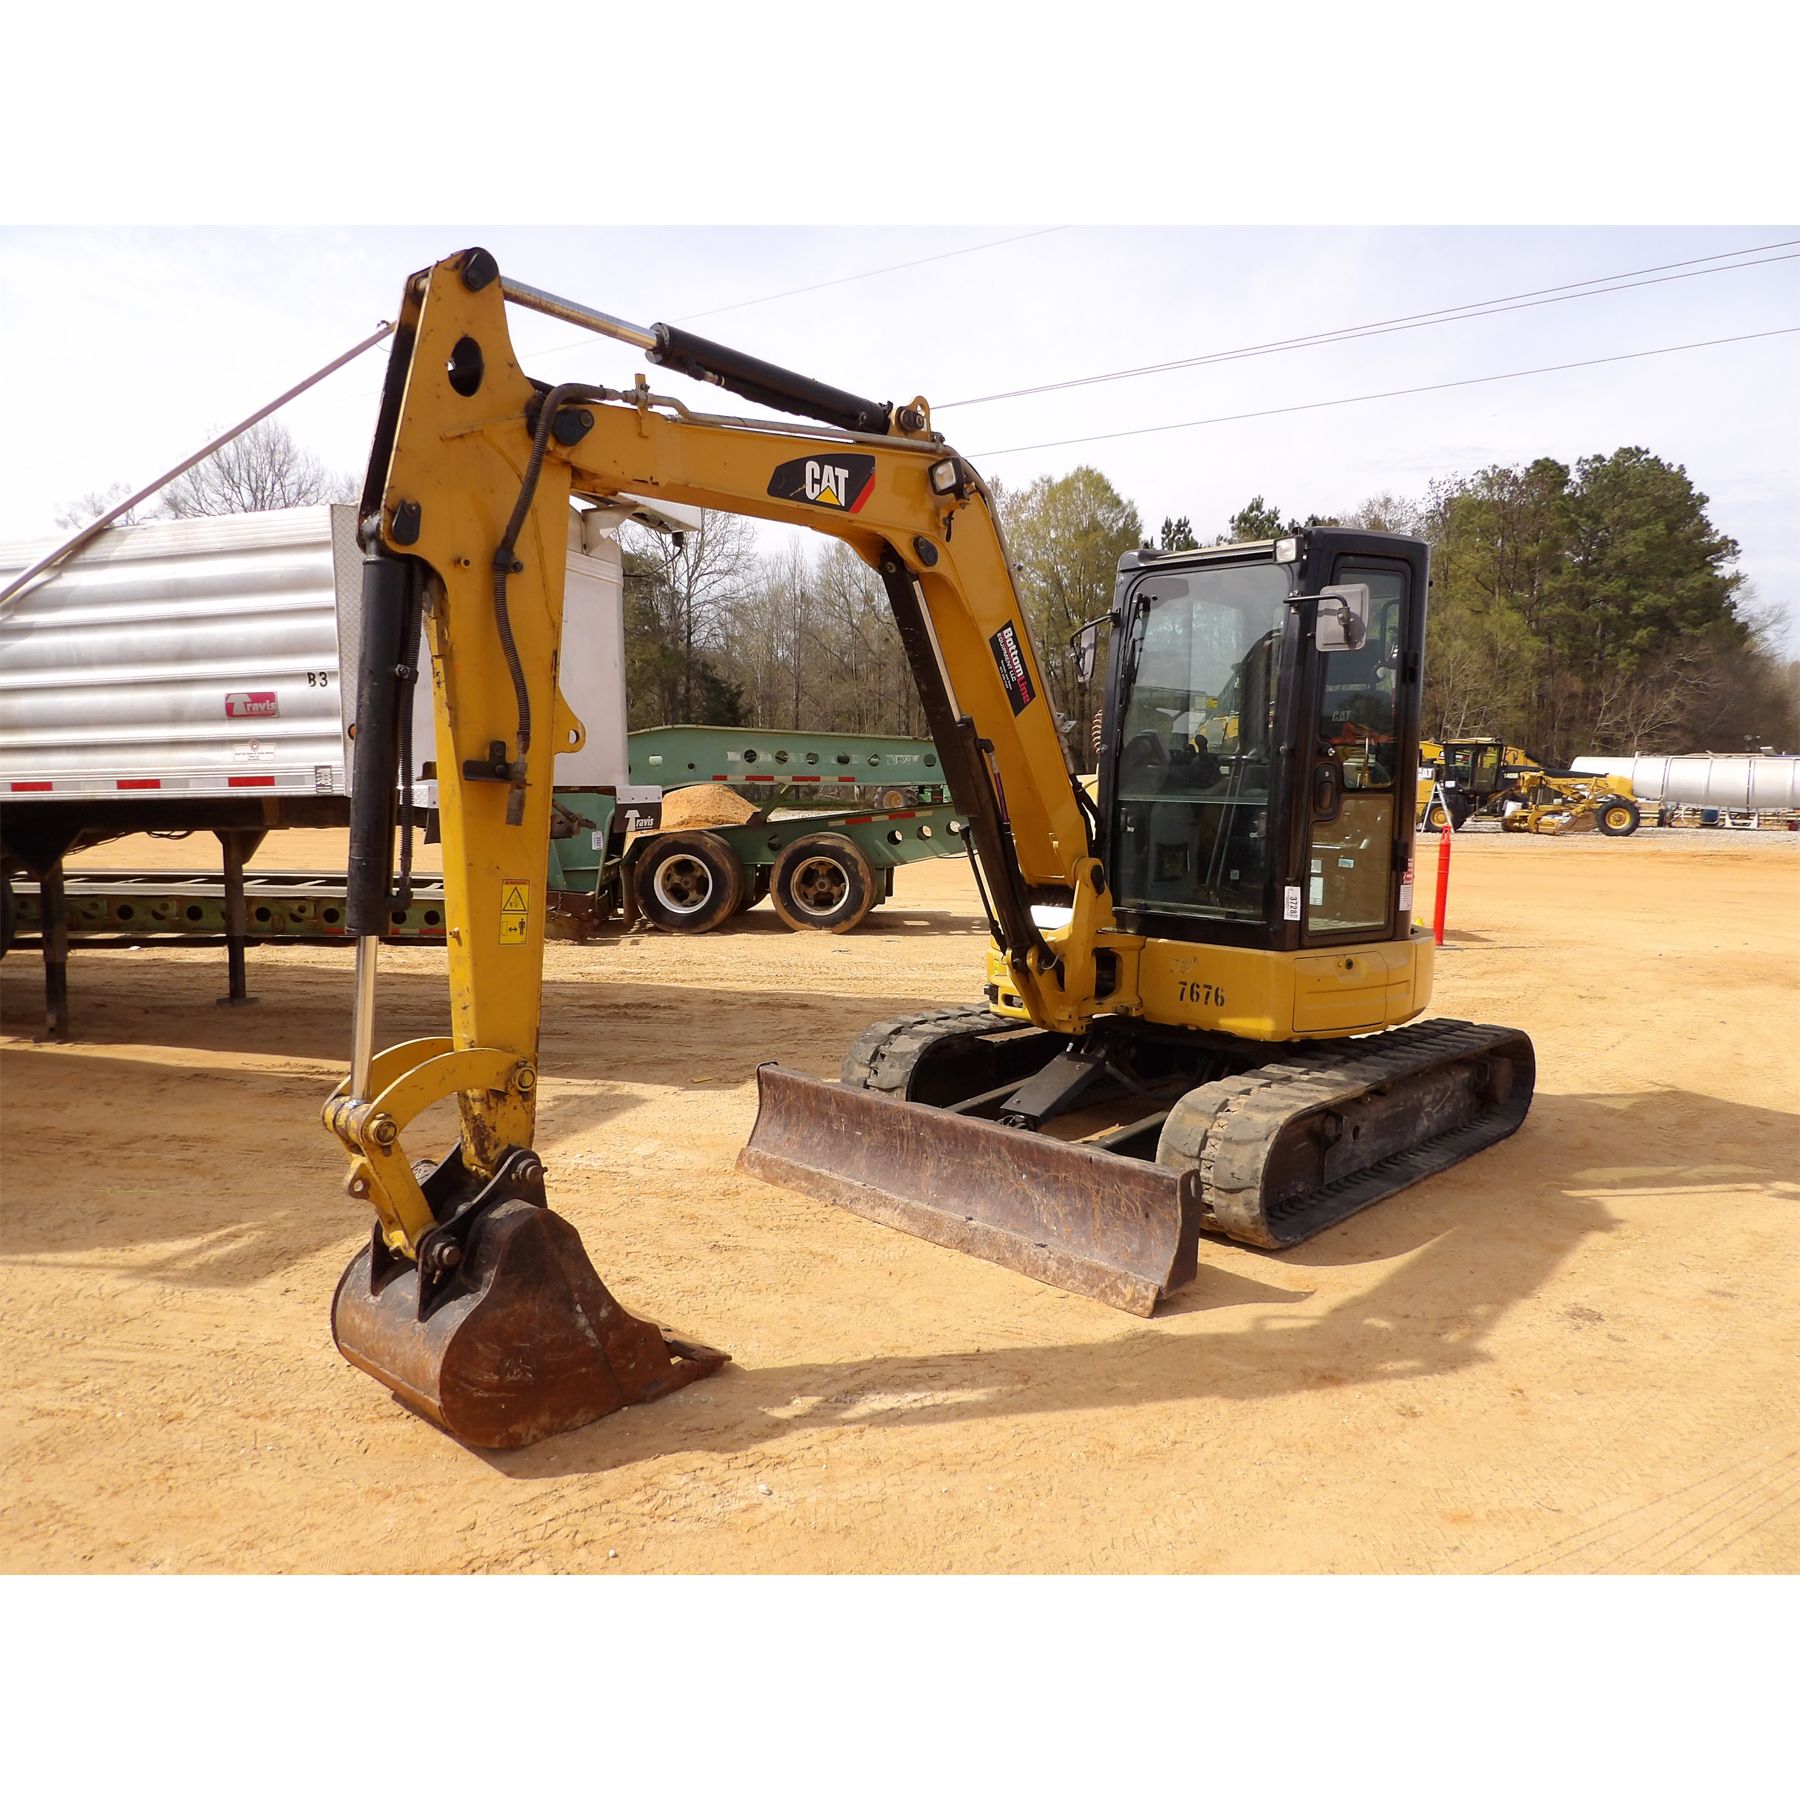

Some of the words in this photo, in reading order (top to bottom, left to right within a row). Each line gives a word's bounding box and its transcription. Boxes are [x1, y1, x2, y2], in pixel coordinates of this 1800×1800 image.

[805, 460, 849, 507] CAT
[997, 632, 1012, 670] EQUIPMENT
[1009, 669, 1017, 682] LLC
[226, 693, 277, 716] Travis
[625, 810, 654, 831] Travis
[1289, 896, 1298, 914] 3728
[1178, 981, 1225, 1008] 7676
